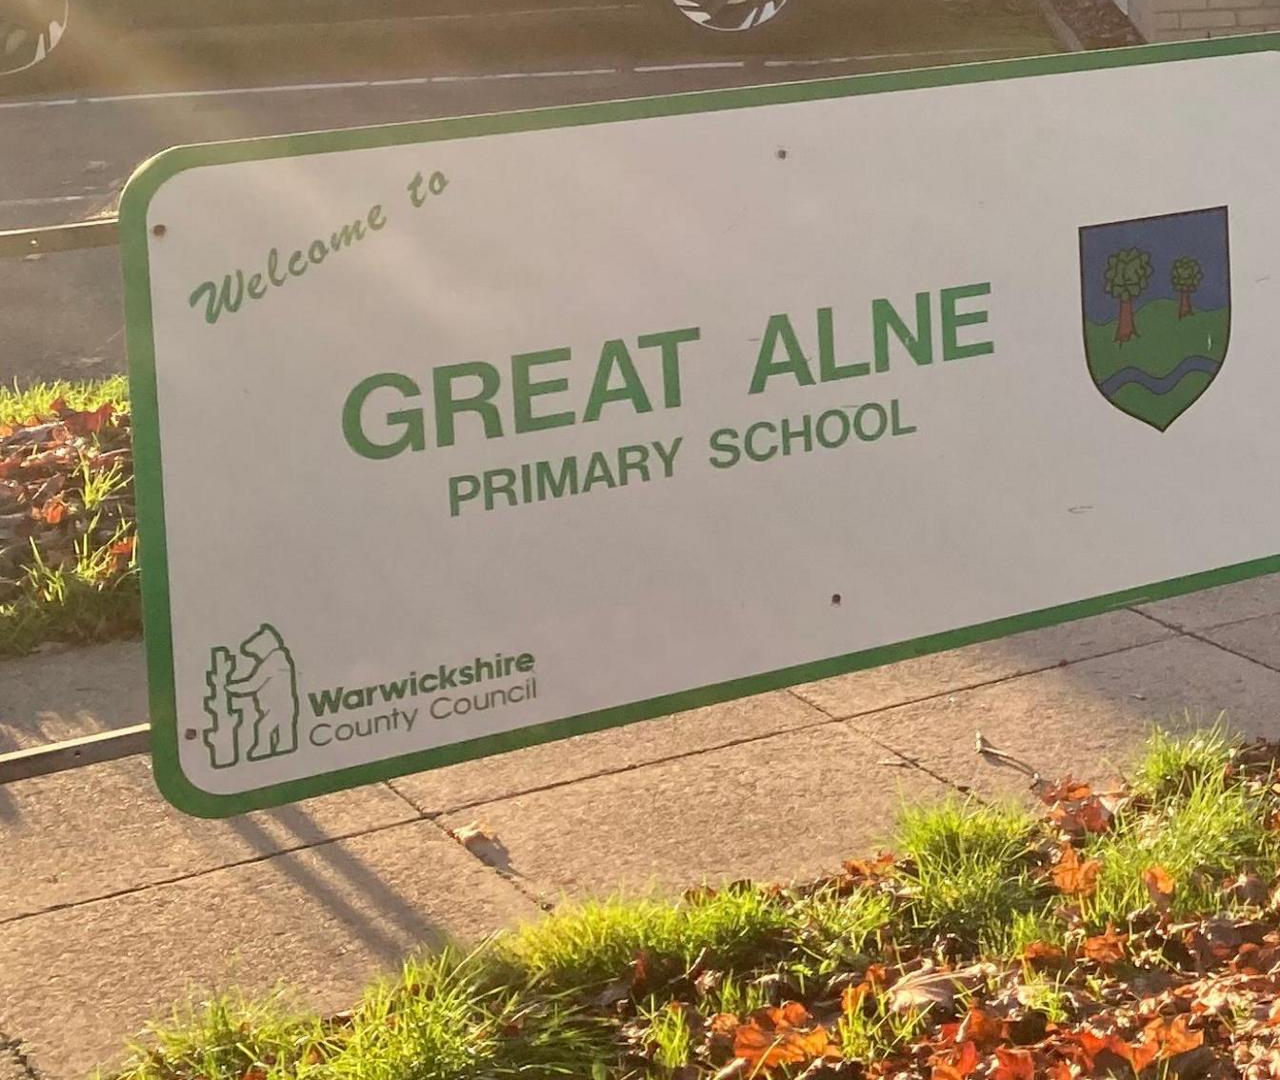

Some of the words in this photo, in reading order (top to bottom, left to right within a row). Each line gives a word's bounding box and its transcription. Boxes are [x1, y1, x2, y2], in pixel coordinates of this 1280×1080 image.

[189, 205, 387, 324] Welcome
[408, 172, 448, 208] to
[342, 327, 700, 460] GREAT
[748, 282, 994, 394] ALNE
[449, 437, 683, 517] PRIMARY
[709, 399, 917, 468] SCHOOL
[308, 653, 535, 717] Warwickshire
[309, 708, 417, 746] County
[430, 677, 536, 719] Council
